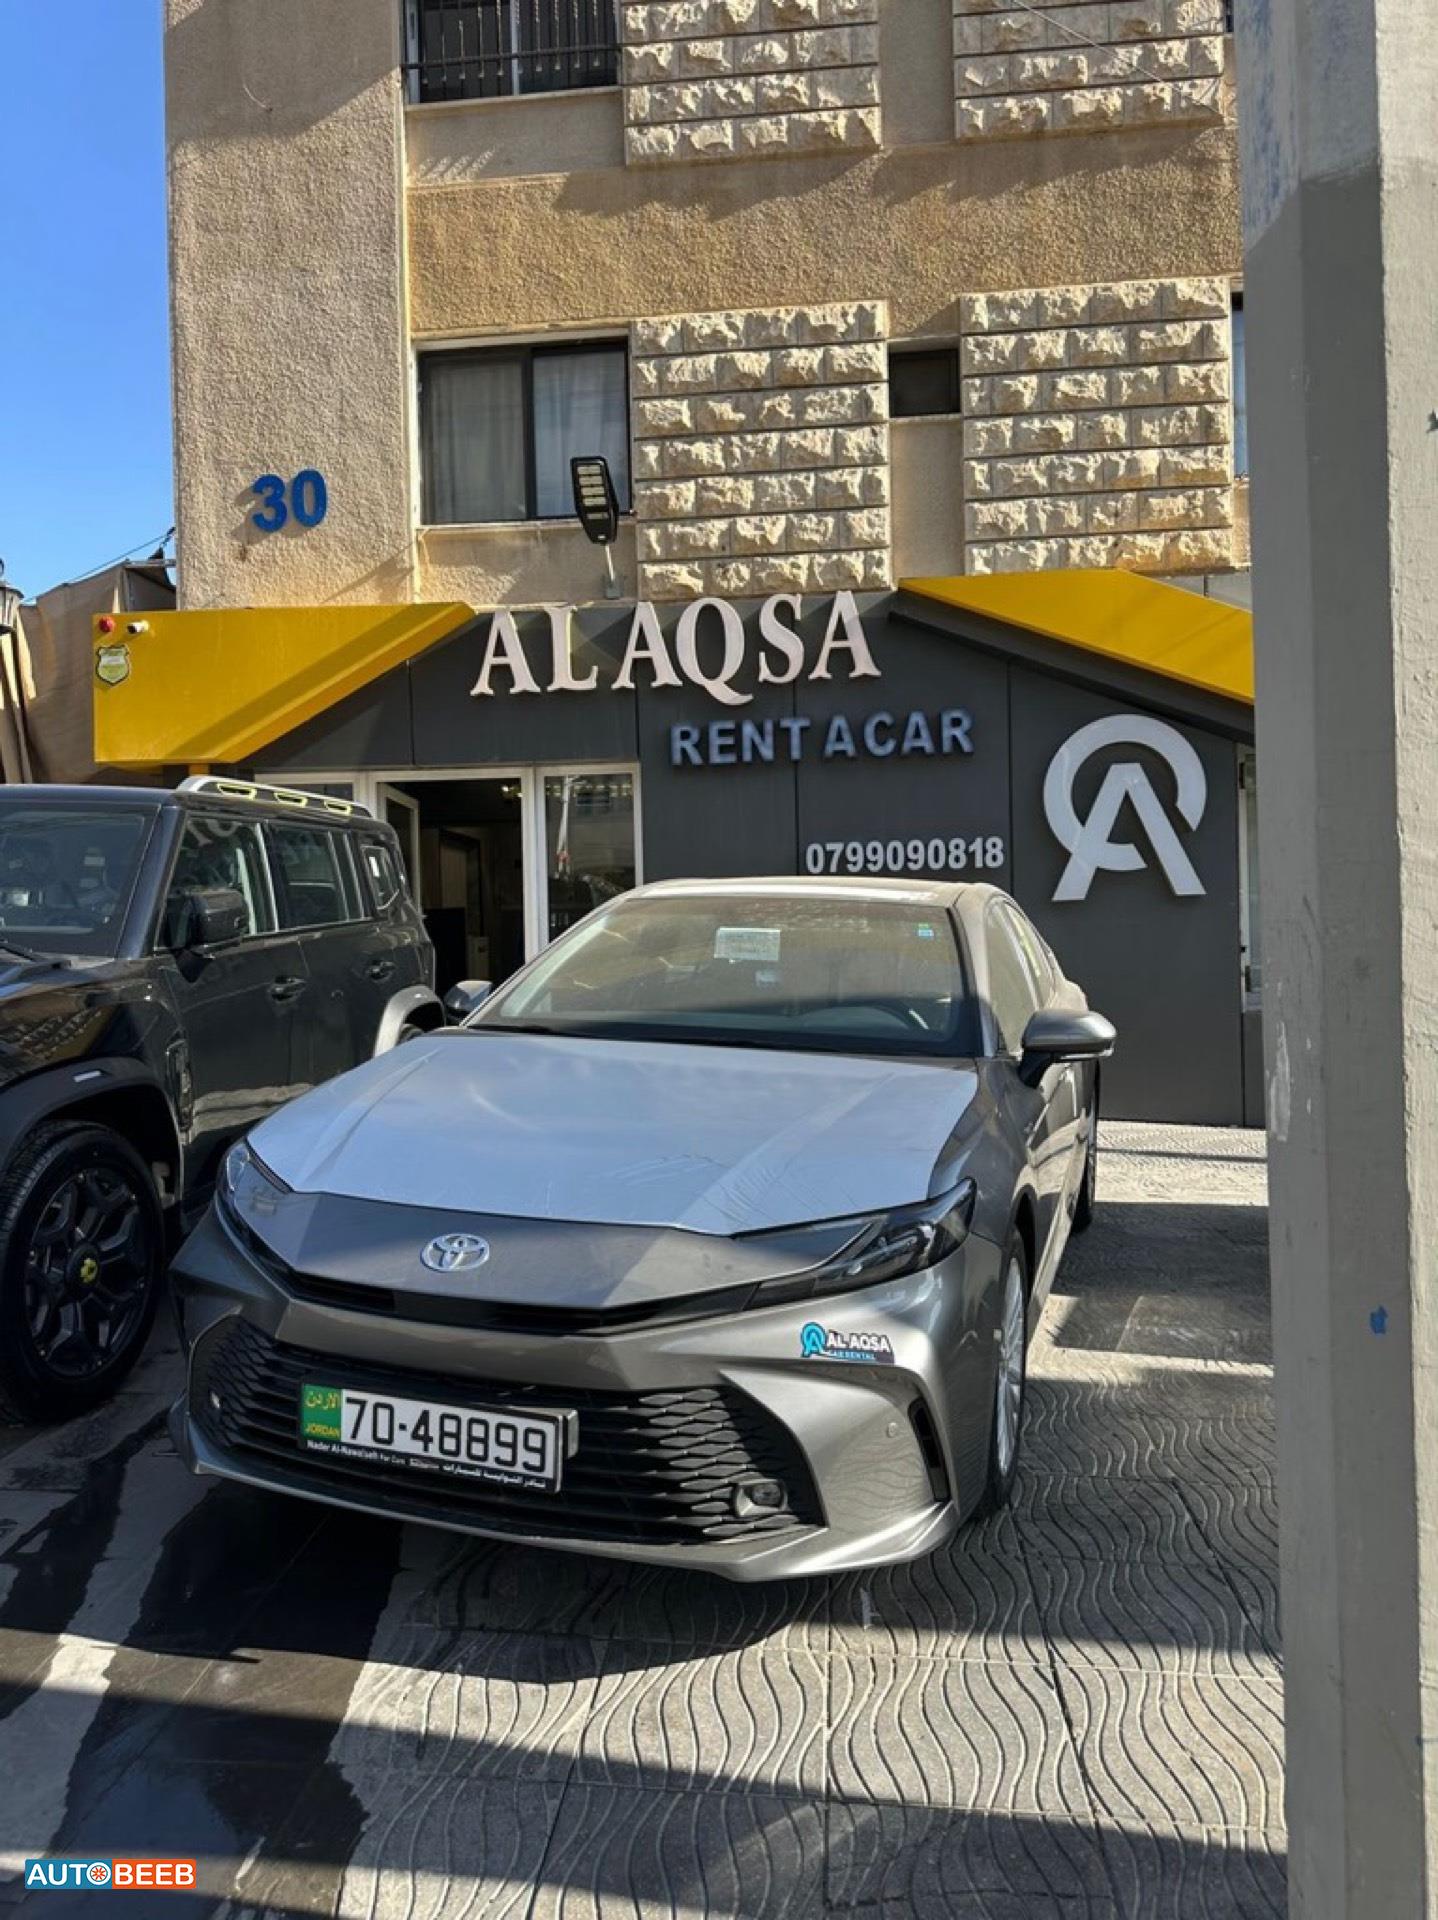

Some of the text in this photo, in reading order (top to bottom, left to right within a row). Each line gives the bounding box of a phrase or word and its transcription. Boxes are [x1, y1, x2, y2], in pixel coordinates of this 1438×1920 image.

[252, 469, 327, 533] 30
[470, 590, 881, 705] AL AQSA
[670, 707, 975, 766] RENT A CAR
[806, 836, 1004, 875] 0799090818
[305, 1423, 341, 1439] JORDAN
[346, 1396, 547, 1473] 70-48899
